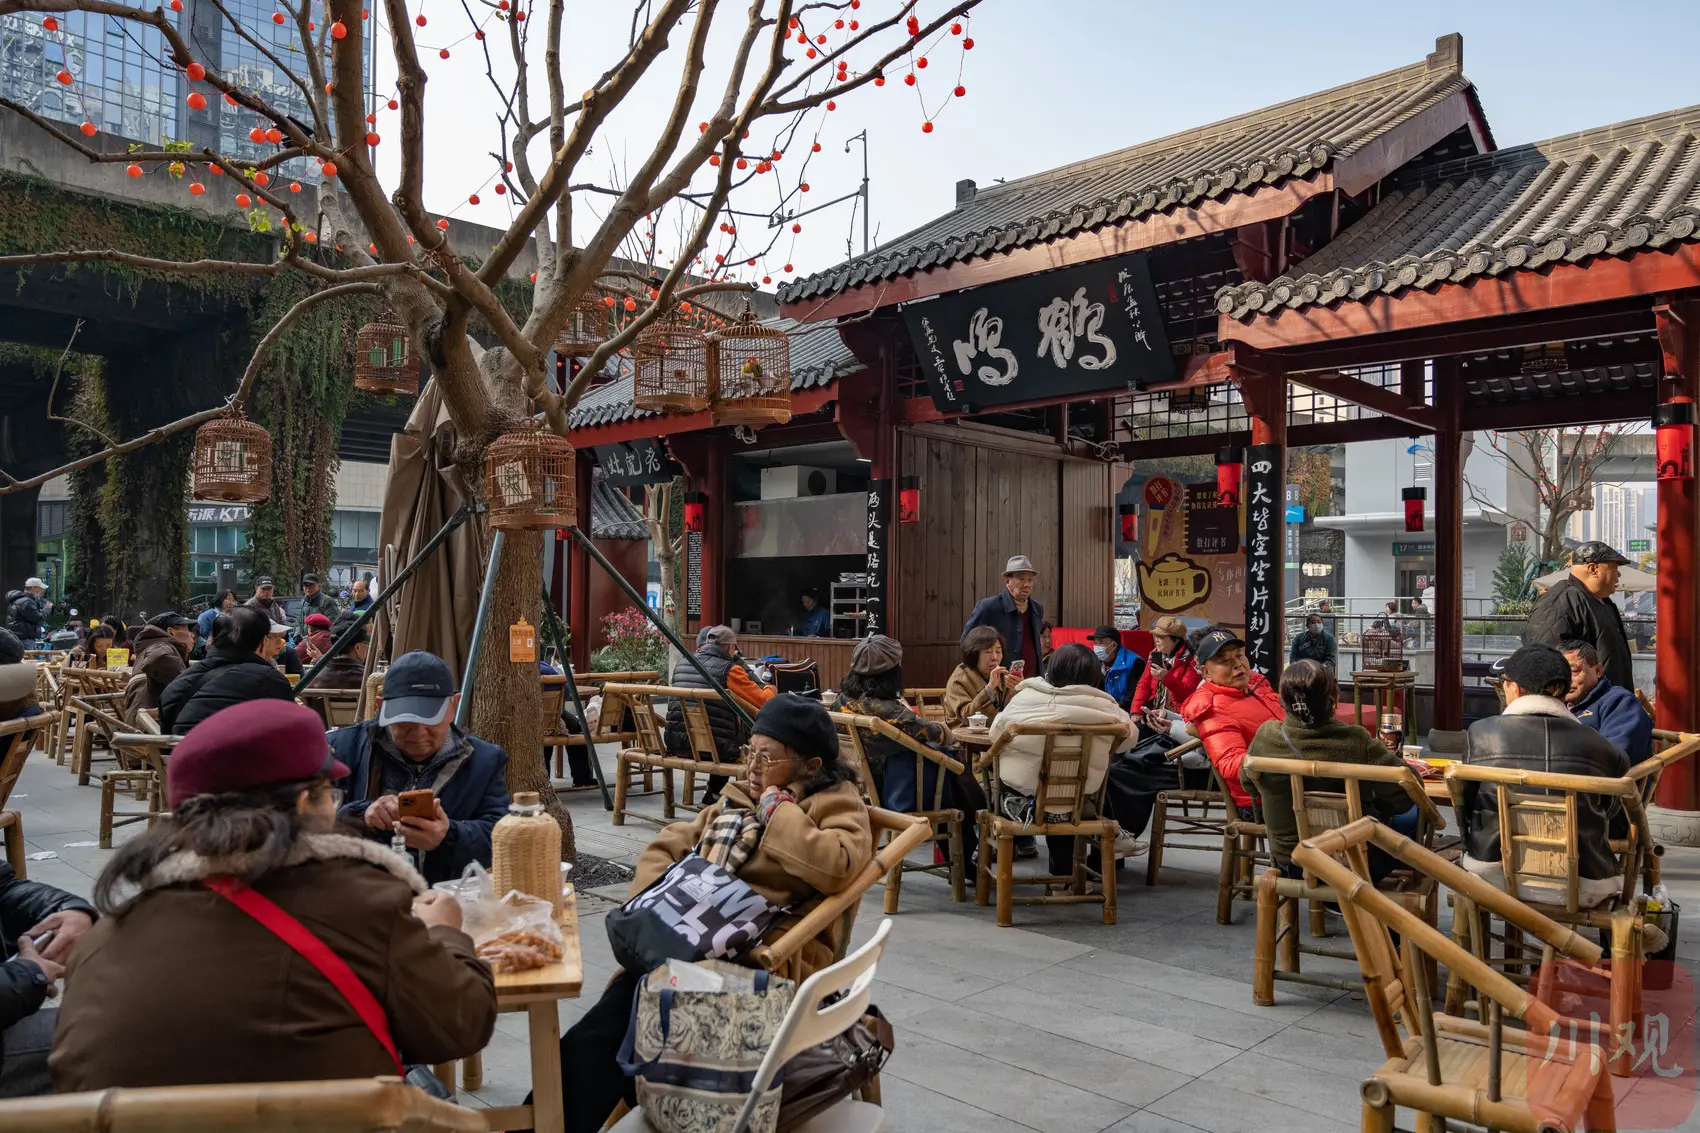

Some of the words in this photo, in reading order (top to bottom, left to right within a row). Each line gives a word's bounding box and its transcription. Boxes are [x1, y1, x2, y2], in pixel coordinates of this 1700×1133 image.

[866, 491, 882, 642] 两头是路吃一盏
